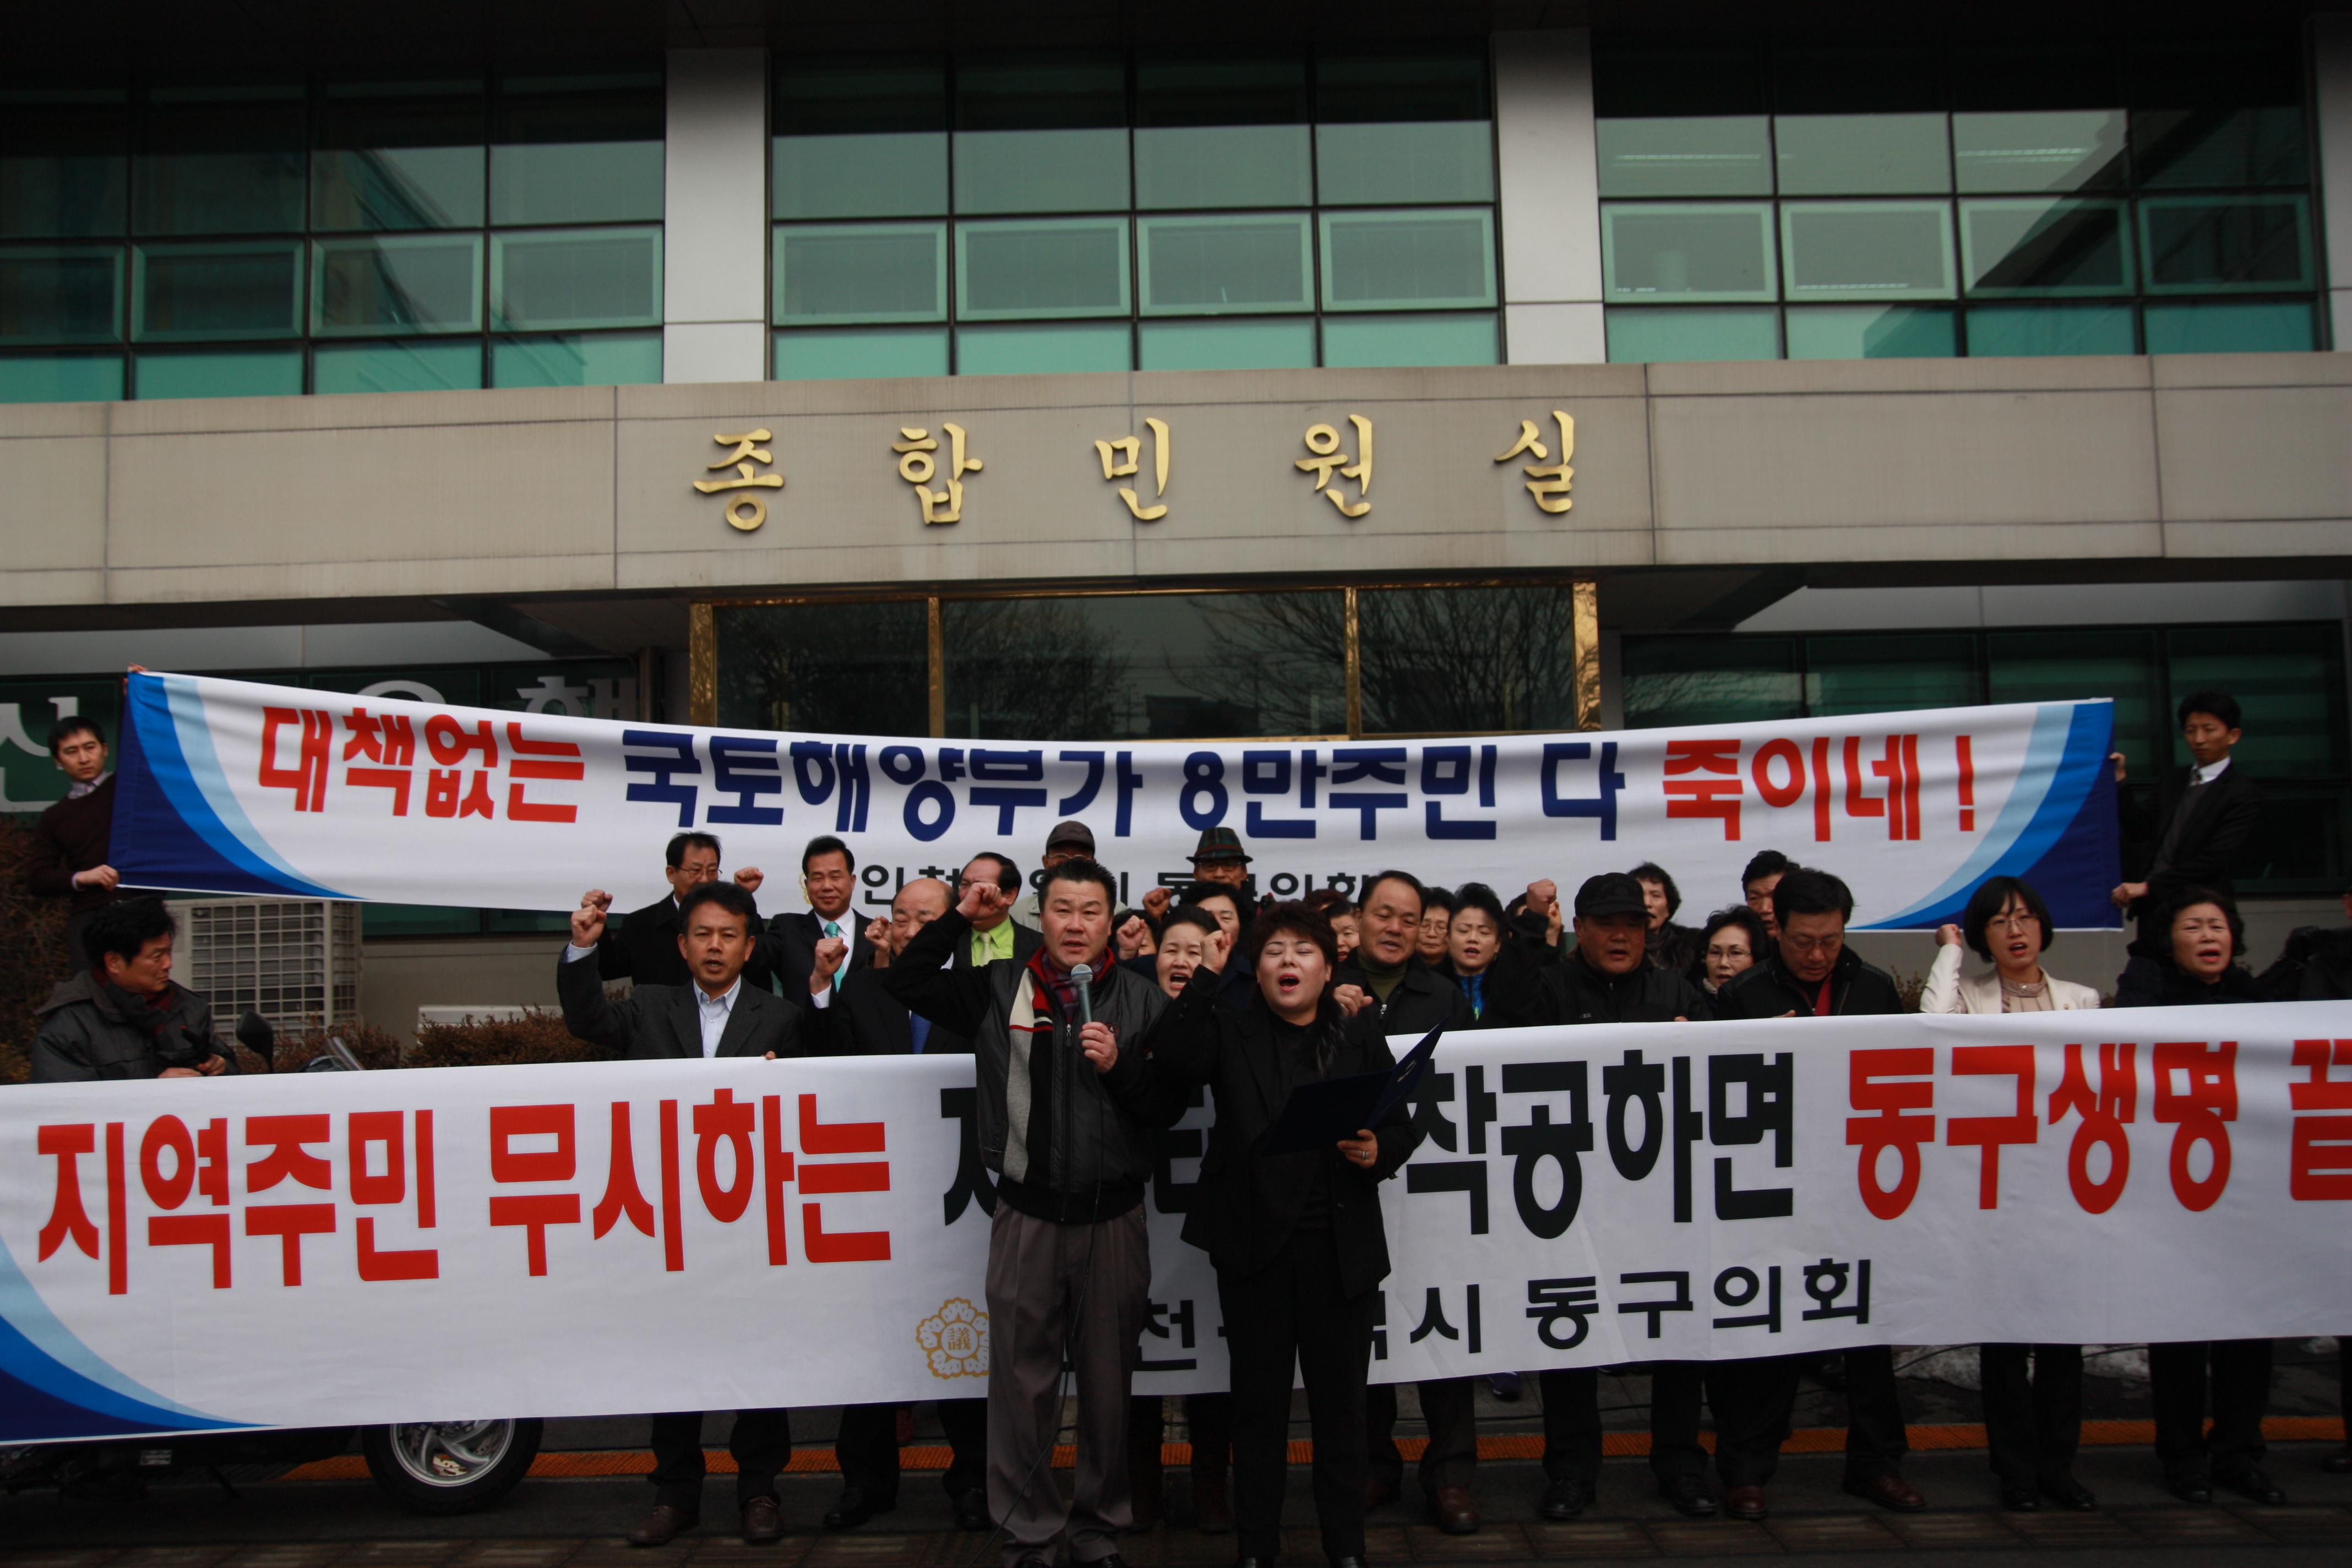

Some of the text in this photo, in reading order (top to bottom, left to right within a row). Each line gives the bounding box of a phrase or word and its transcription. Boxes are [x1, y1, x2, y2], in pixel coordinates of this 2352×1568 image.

[258, 706, 585, 824] 대책없는
[622, 729, 1144, 842] 국토해양부가
[1179, 742, 1497, 841] 8만주민
[1542, 741, 1626, 841] 다
[37, 1109, 440, 1295] 지역주민
[489, 1088, 892, 1277] 무시하는
[1406, 1049, 1794, 1240] 착공하면
[1845, 1041, 2239, 1221] 동구생명
[1525, 1257, 1872, 1350] 동구의회
